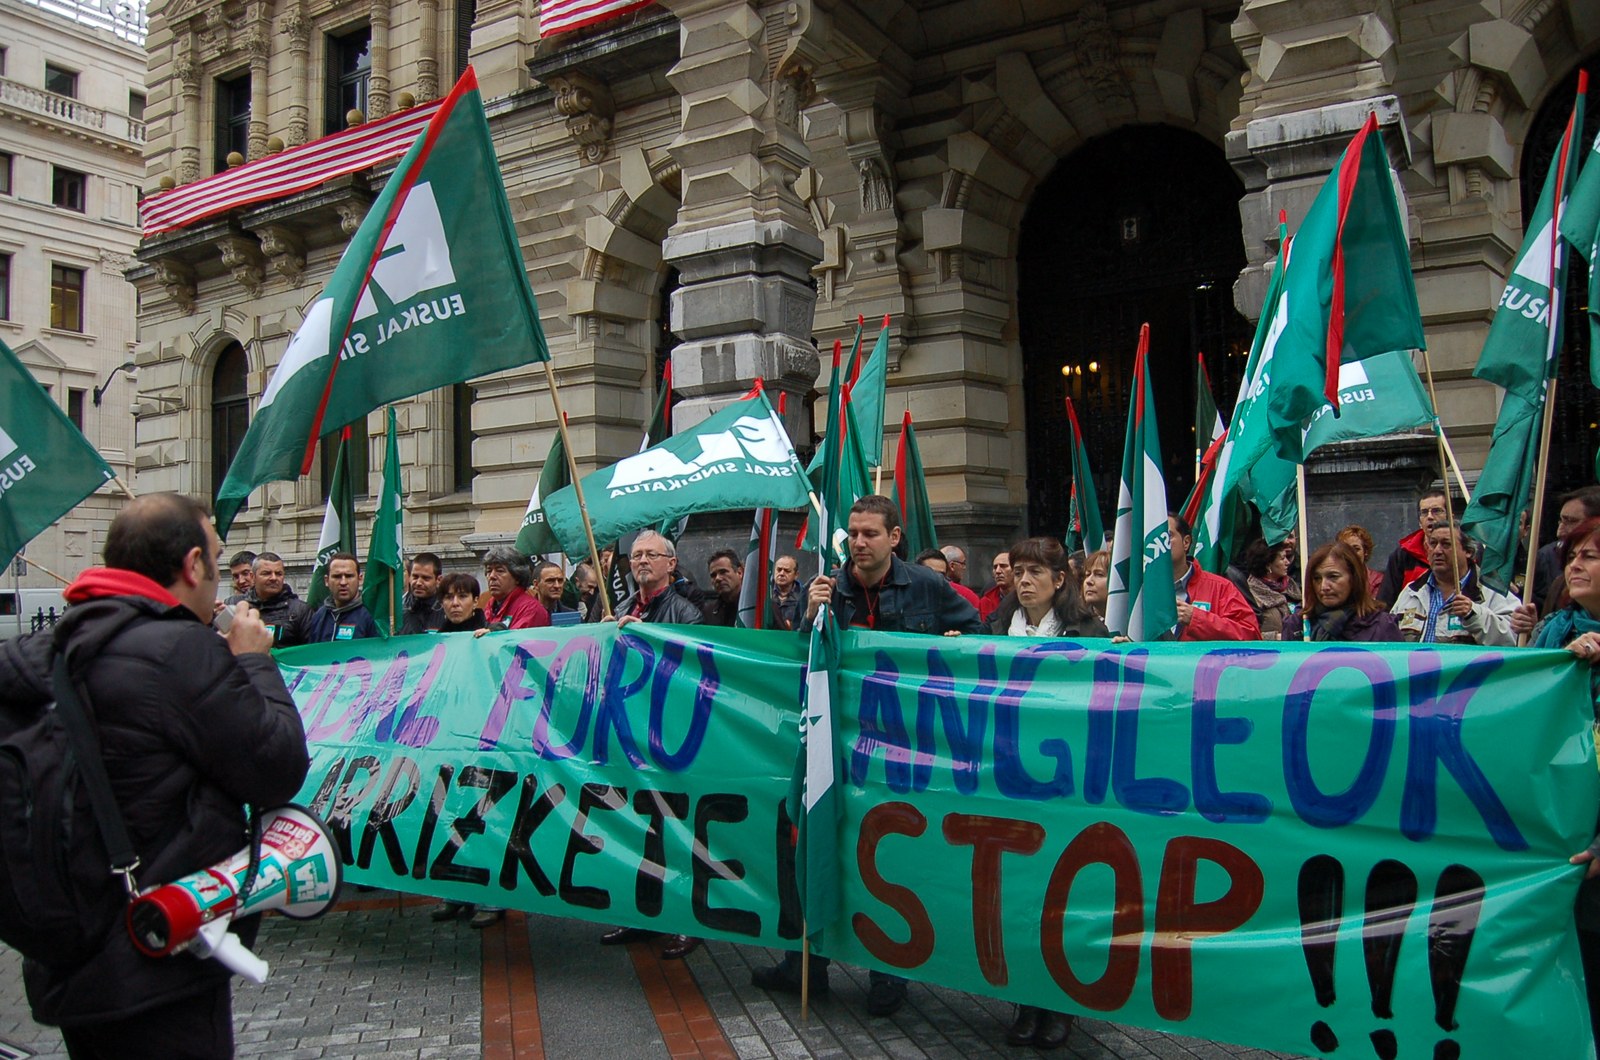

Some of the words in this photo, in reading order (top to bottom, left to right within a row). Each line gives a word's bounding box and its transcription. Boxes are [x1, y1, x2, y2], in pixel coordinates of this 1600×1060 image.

[479, 632, 720, 772] FORU
[852, 801, 1265, 1022] STOP
[1297, 854, 1486, 1060] !!!
